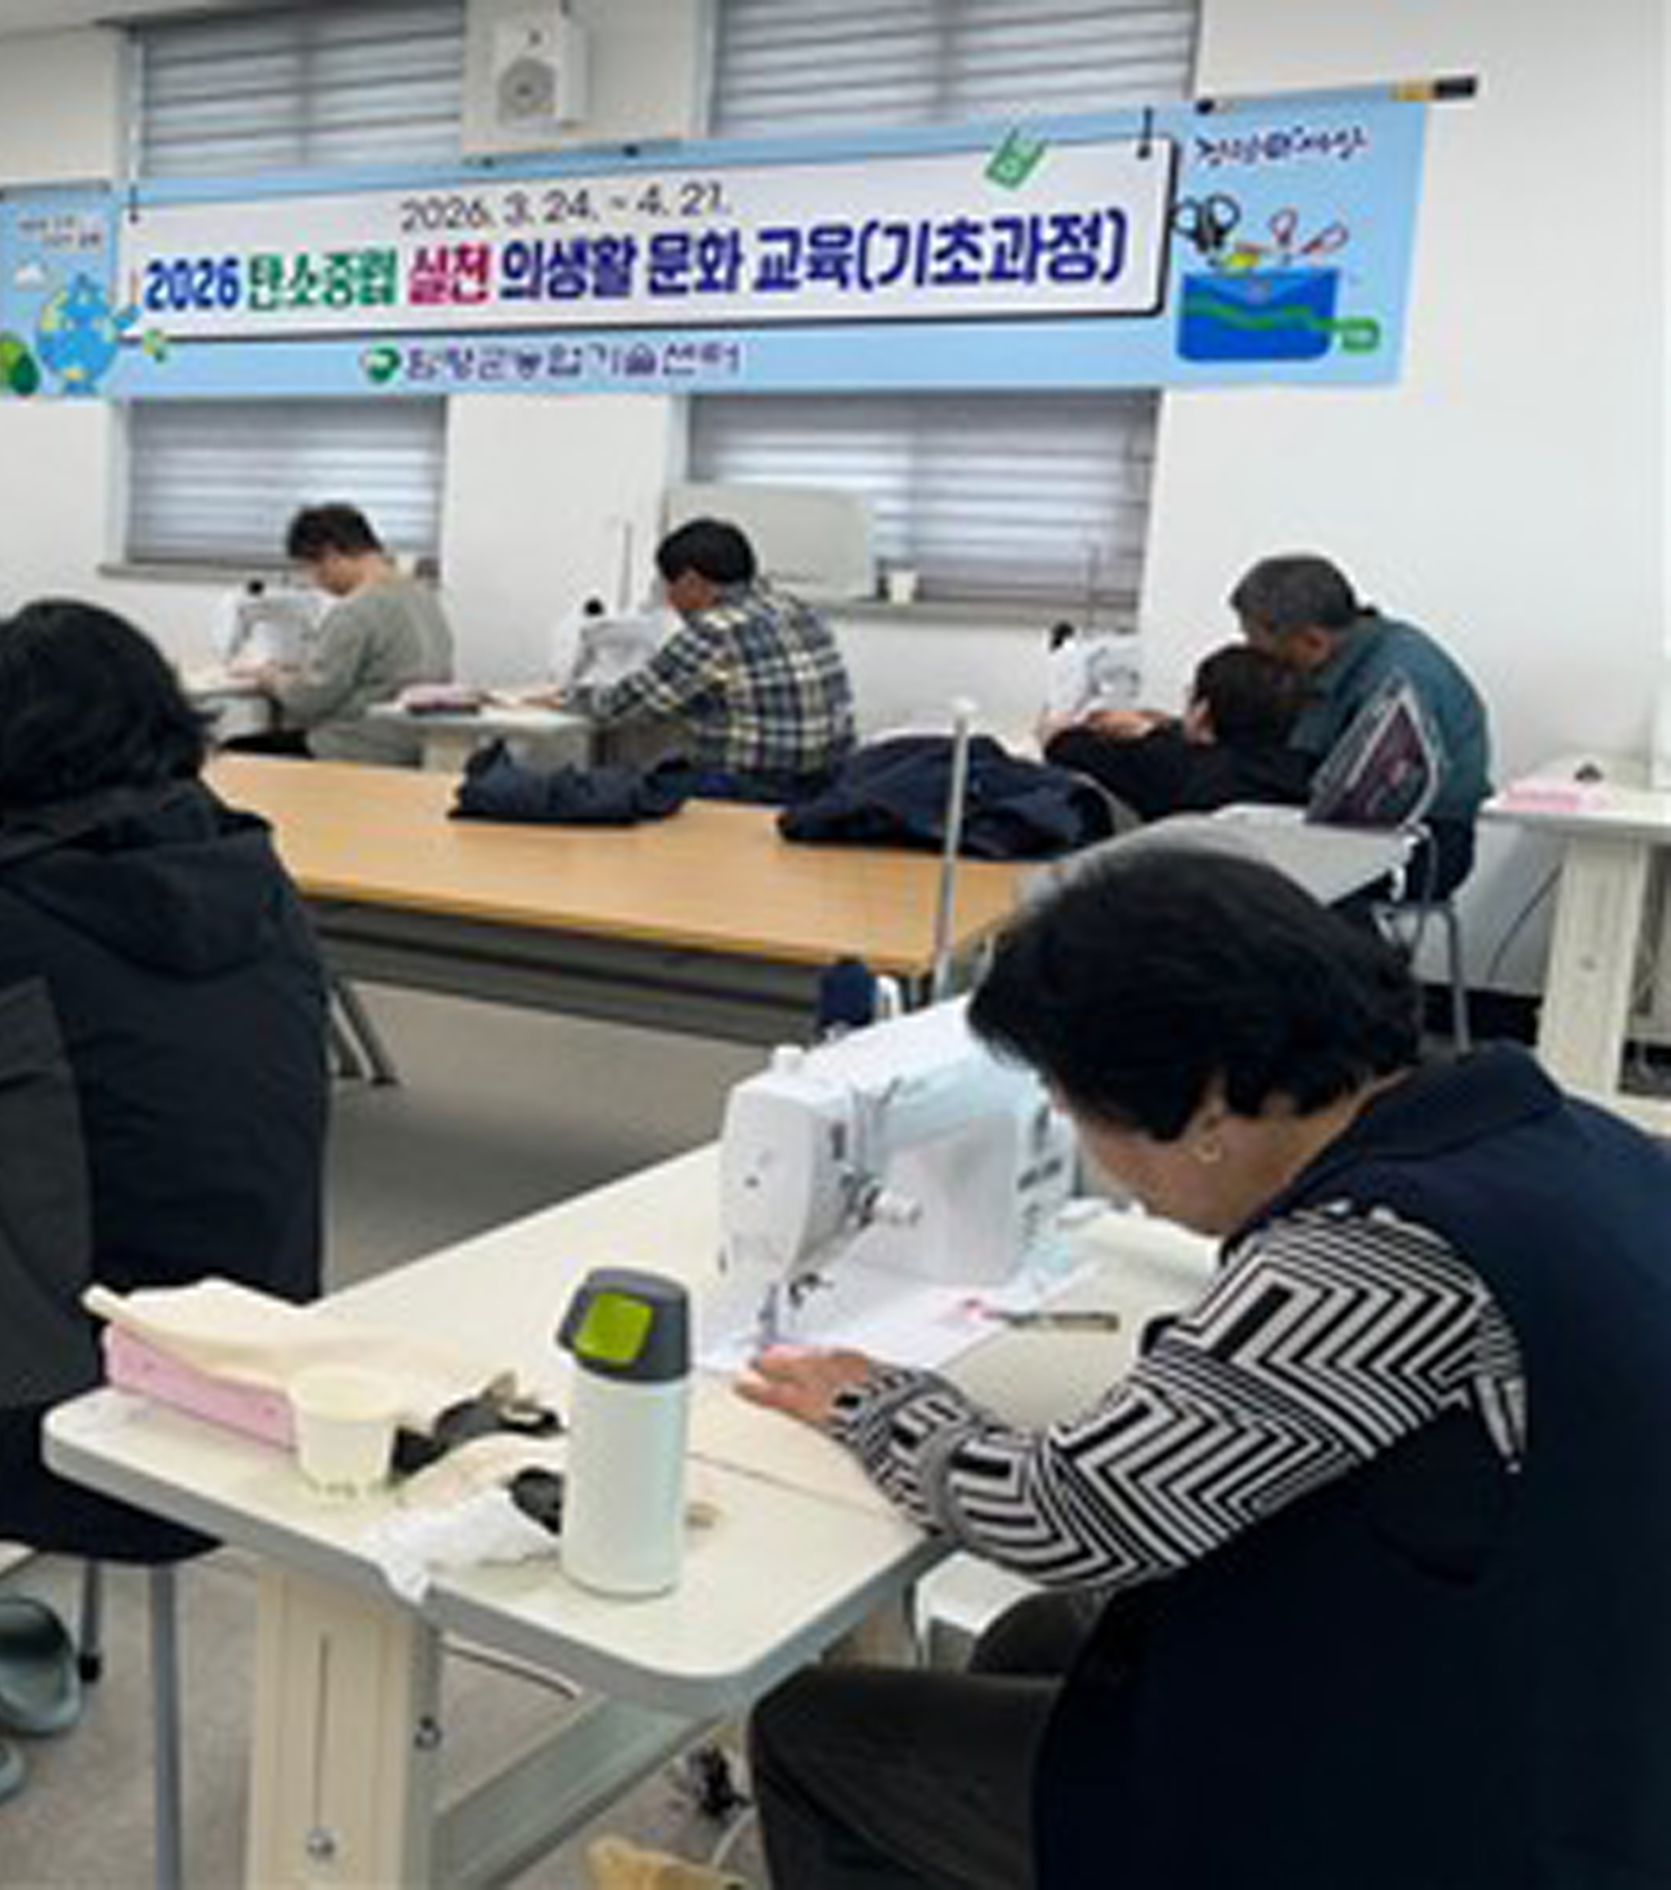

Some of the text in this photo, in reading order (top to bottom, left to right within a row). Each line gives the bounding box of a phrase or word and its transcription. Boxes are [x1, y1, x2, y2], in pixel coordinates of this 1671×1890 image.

[504, 191, 535, 226] 3.
[543, 188, 600, 222] 24.
[637, 183, 672, 216] 4.
[144, 206, 1128, 312] 2026 탄소중립 실천 의생활 문화 교육(기초과정)
